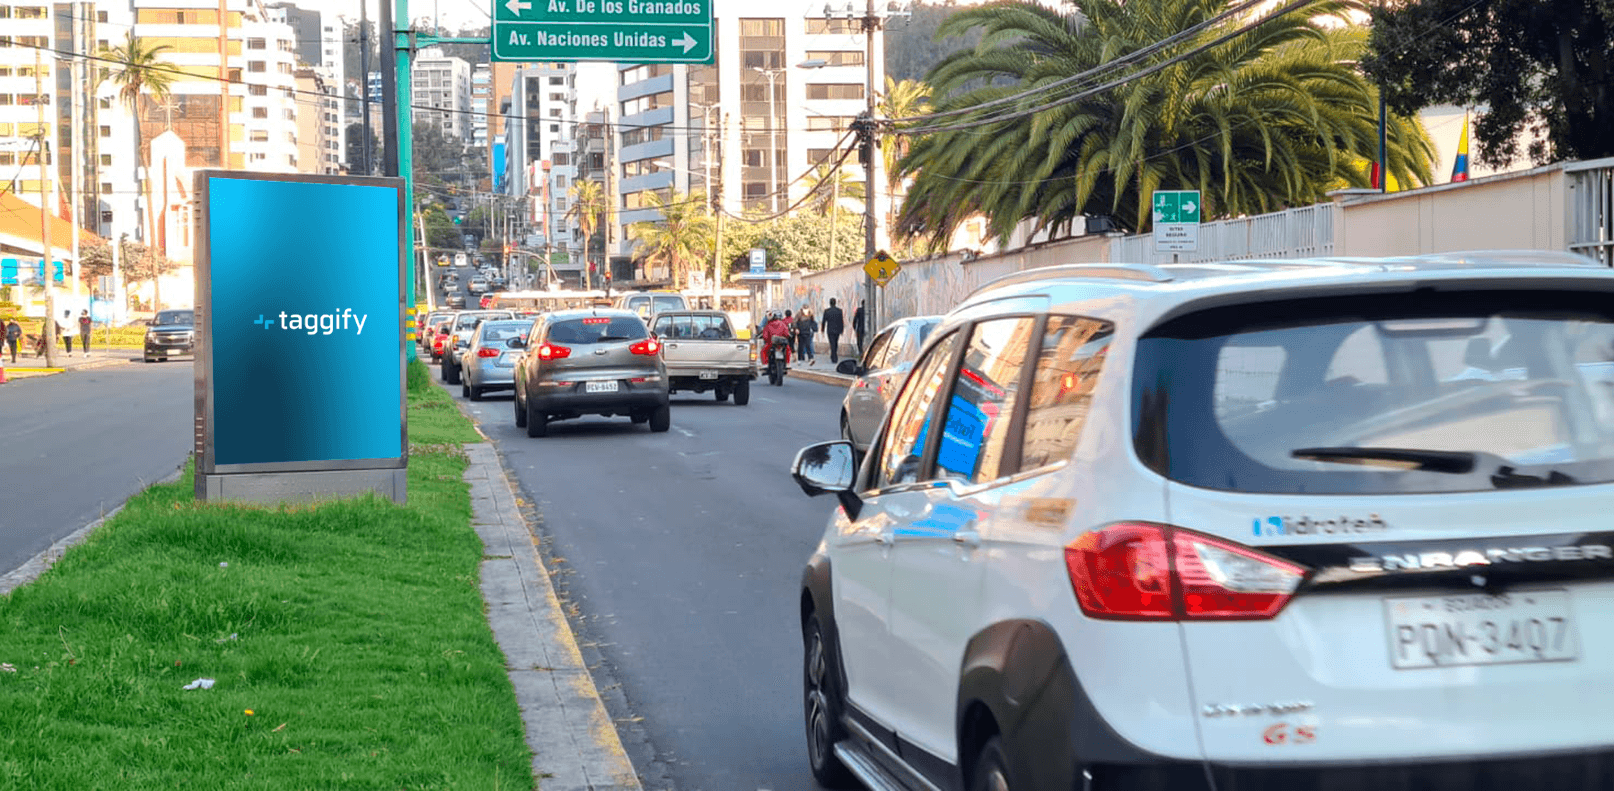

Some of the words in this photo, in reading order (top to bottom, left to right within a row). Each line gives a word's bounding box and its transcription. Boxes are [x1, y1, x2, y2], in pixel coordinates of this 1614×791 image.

[548, 0, 570, 13] Av.
[576, 0, 596, 13] De
[601, 0, 623, 14] los
[628, 0, 701, 15] Granados
[508, 30, 531, 46] Av.
[537, 31, 608, 47] Naciones
[614, 32, 666, 47] Unidas
[278, 307, 368, 335] taggify
